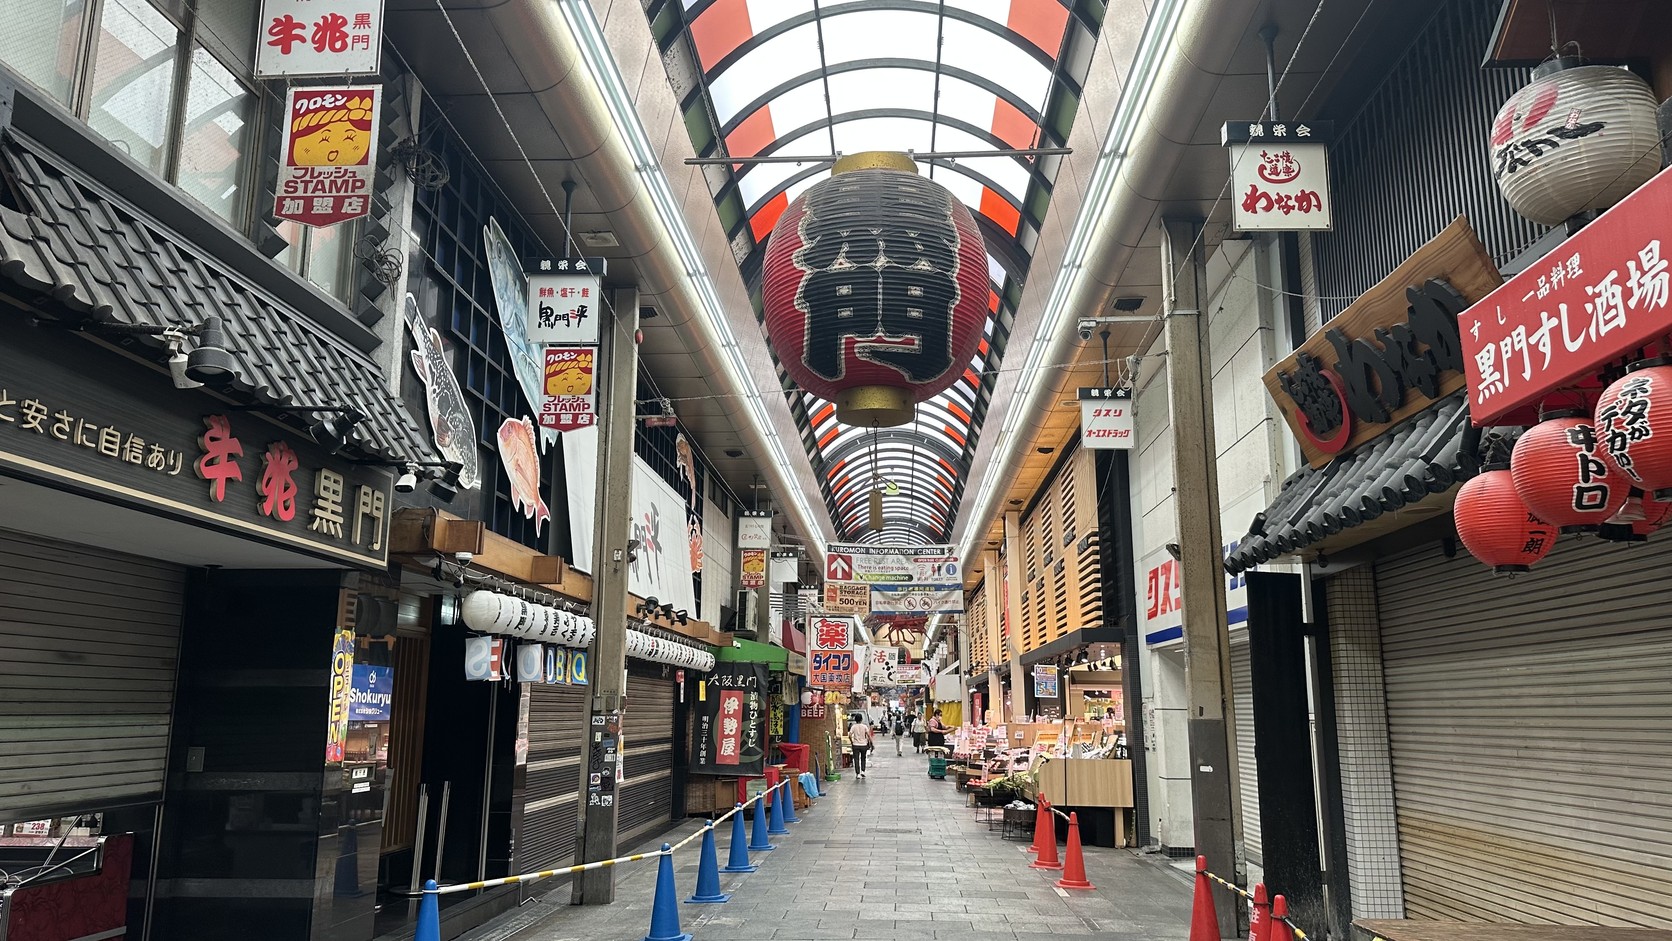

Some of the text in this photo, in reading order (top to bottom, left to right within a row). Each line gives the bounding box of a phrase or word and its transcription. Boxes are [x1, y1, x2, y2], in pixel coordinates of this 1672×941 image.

[267, 12, 349, 54] 牛兆
[351, 12, 371, 51] 黒門
[295, 94, 347, 115] クロモン
[292, 167, 357, 179] フレッシュ
[283, 178, 365, 194] STAMP
[282, 196, 364, 215] 加盟店
[1242, 184, 1322, 215] わなか
[1469, 252, 1584, 342] すし 一品料理
[1475, 239, 1670, 405] 黒門すし酒場
[547, 351, 578, 363] クロモン
[543, 403, 591, 412] STAMP
[1093, 408, 1124, 418] クスリ
[1620, 378, 1651, 441] ネタが
[542, 414, 590, 425] 加盟店
[195, 414, 299, 522] 牛兆
[307, 467, 385, 552] 黒門
[839, 597, 854, 606] 500
[816, 619, 849, 648] 薬
[813, 652, 851, 671] ダイコク
[329, 651, 346, 745] OPEN
[349, 687, 391, 707] Shokuryu
[801, 709, 825, 717] BEEF
[721, 697, 740, 756] 伊勢屋
